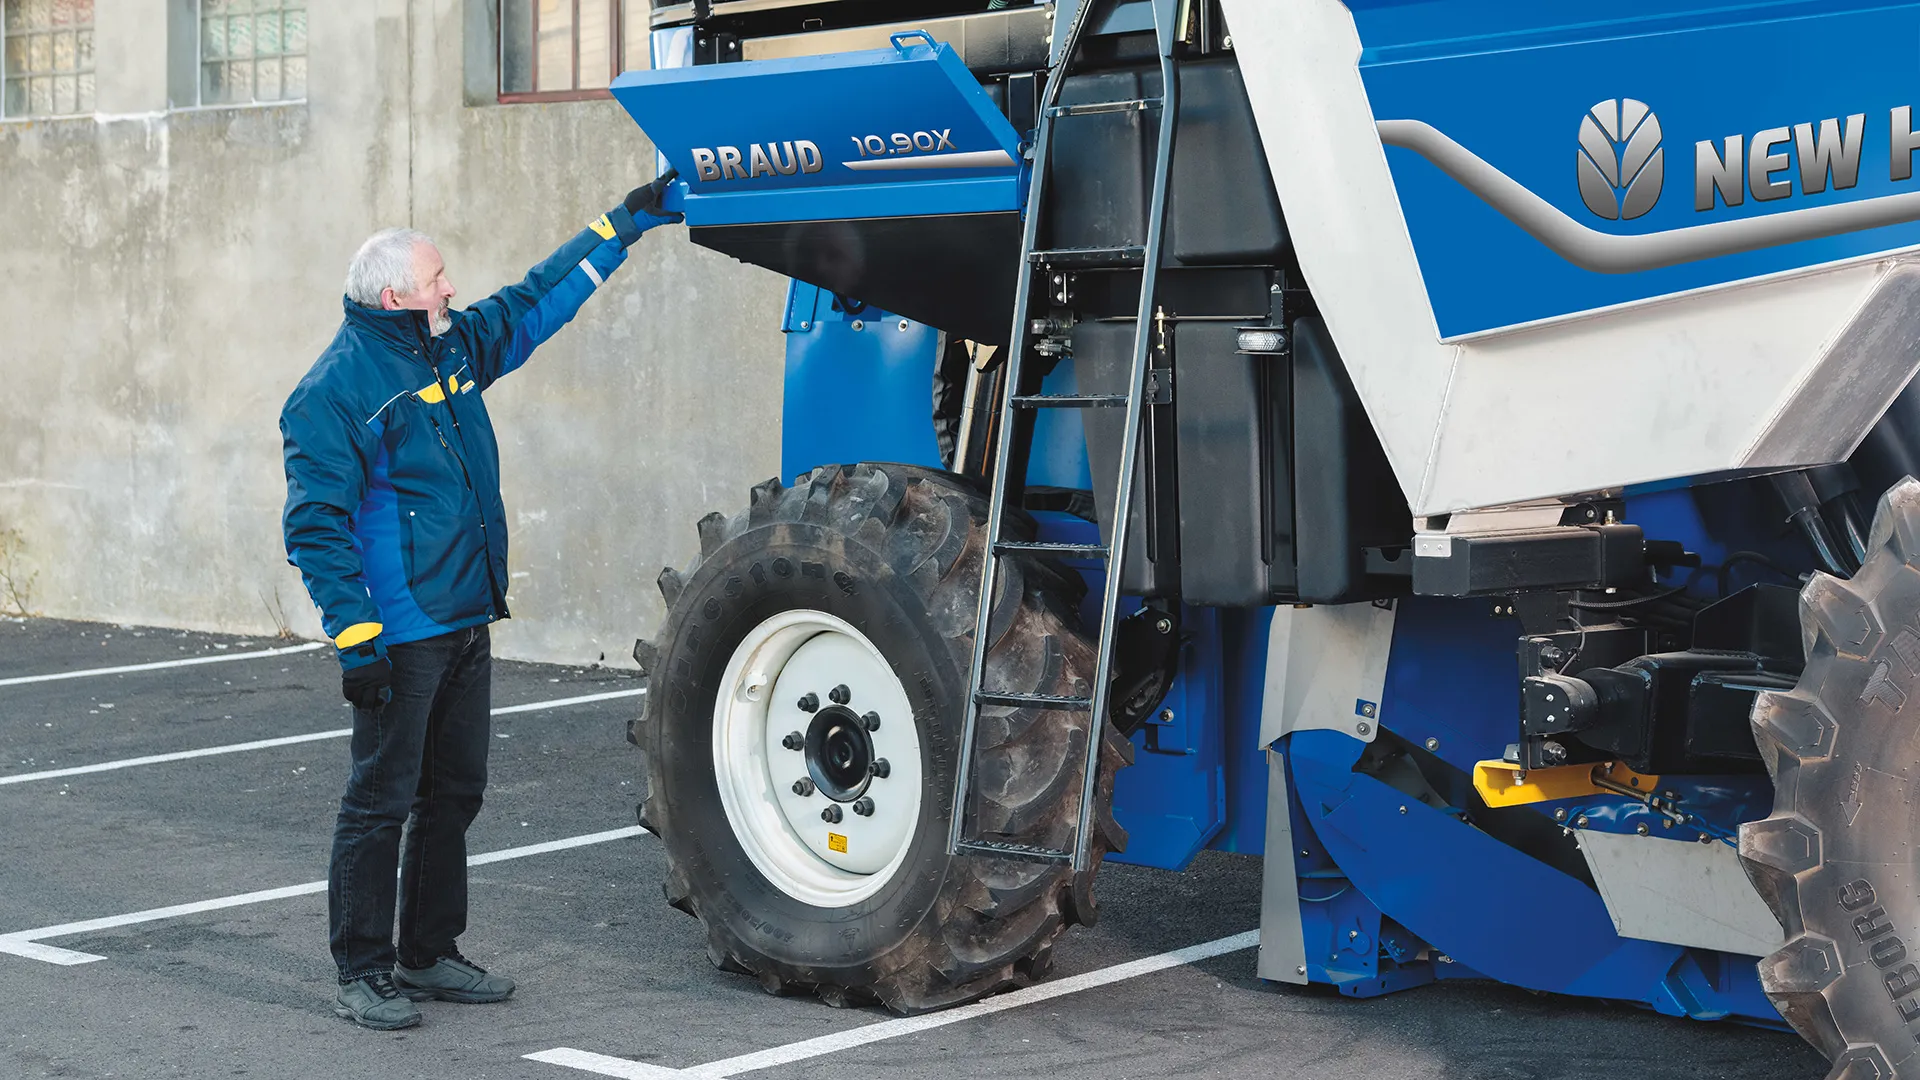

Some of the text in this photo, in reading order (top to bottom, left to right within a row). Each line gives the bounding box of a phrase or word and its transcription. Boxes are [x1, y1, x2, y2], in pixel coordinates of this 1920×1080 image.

[691, 128, 958, 182] BRAUD 10.90X
[1694, 112, 1867, 212] NEW
[1837, 878, 1920, 1047] EBORG
